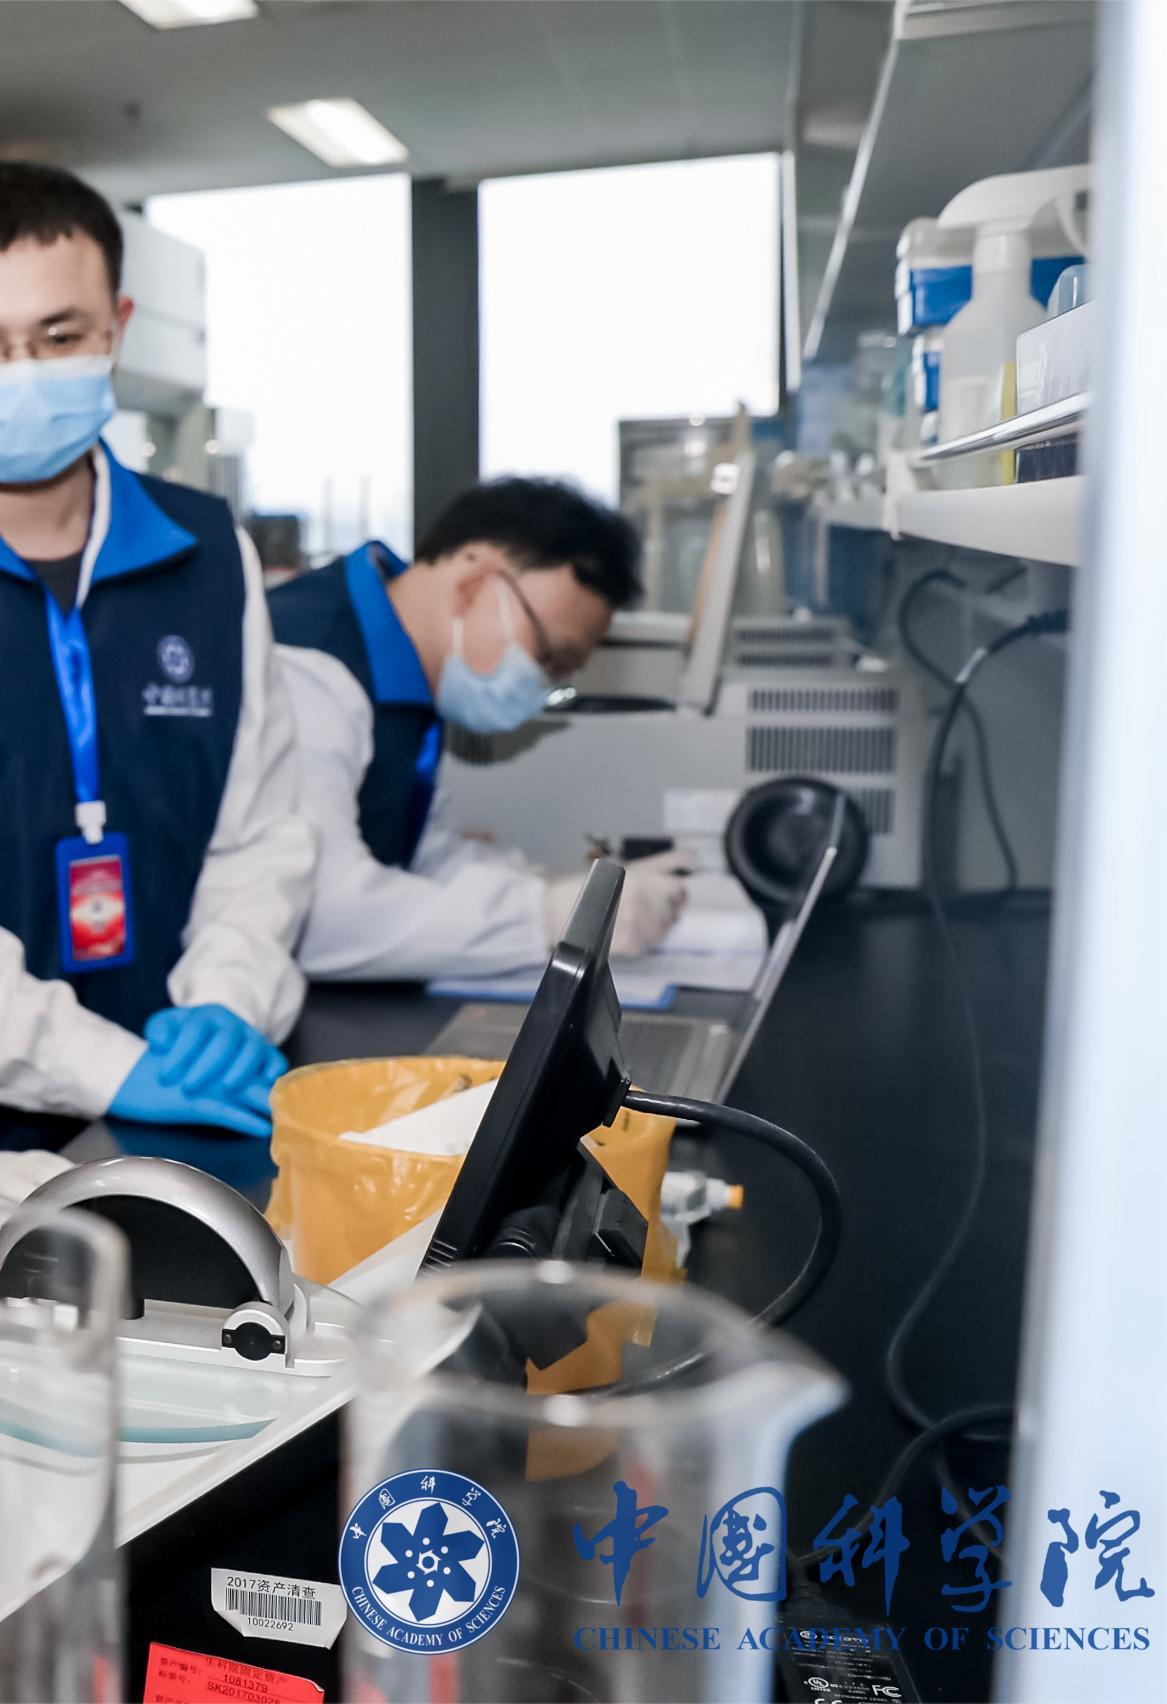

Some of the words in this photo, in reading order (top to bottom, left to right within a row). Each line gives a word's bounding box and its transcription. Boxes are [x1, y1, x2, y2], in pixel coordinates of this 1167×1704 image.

[226, 1576, 316, 1599] 2017资产清查
[247, 1617, 294, 1632] 10022692
